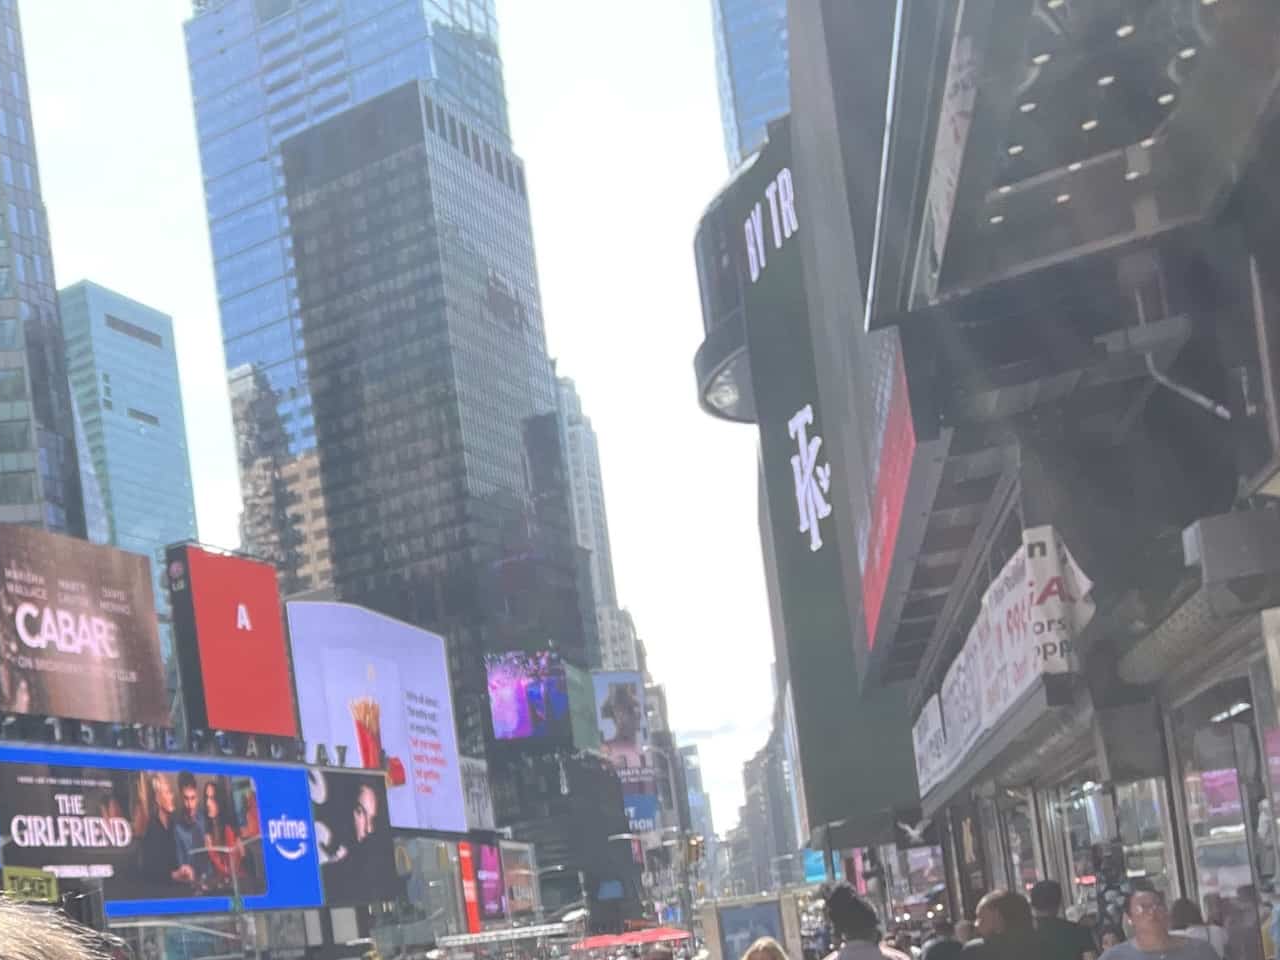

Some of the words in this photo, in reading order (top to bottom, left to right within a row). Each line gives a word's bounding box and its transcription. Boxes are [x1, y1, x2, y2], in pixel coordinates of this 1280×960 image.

[744, 201, 766, 283] BY
[55, 794, 86, 816] THE
[10, 814, 133, 848] GIRLFRIEND
[268, 816, 308, 842] prime
